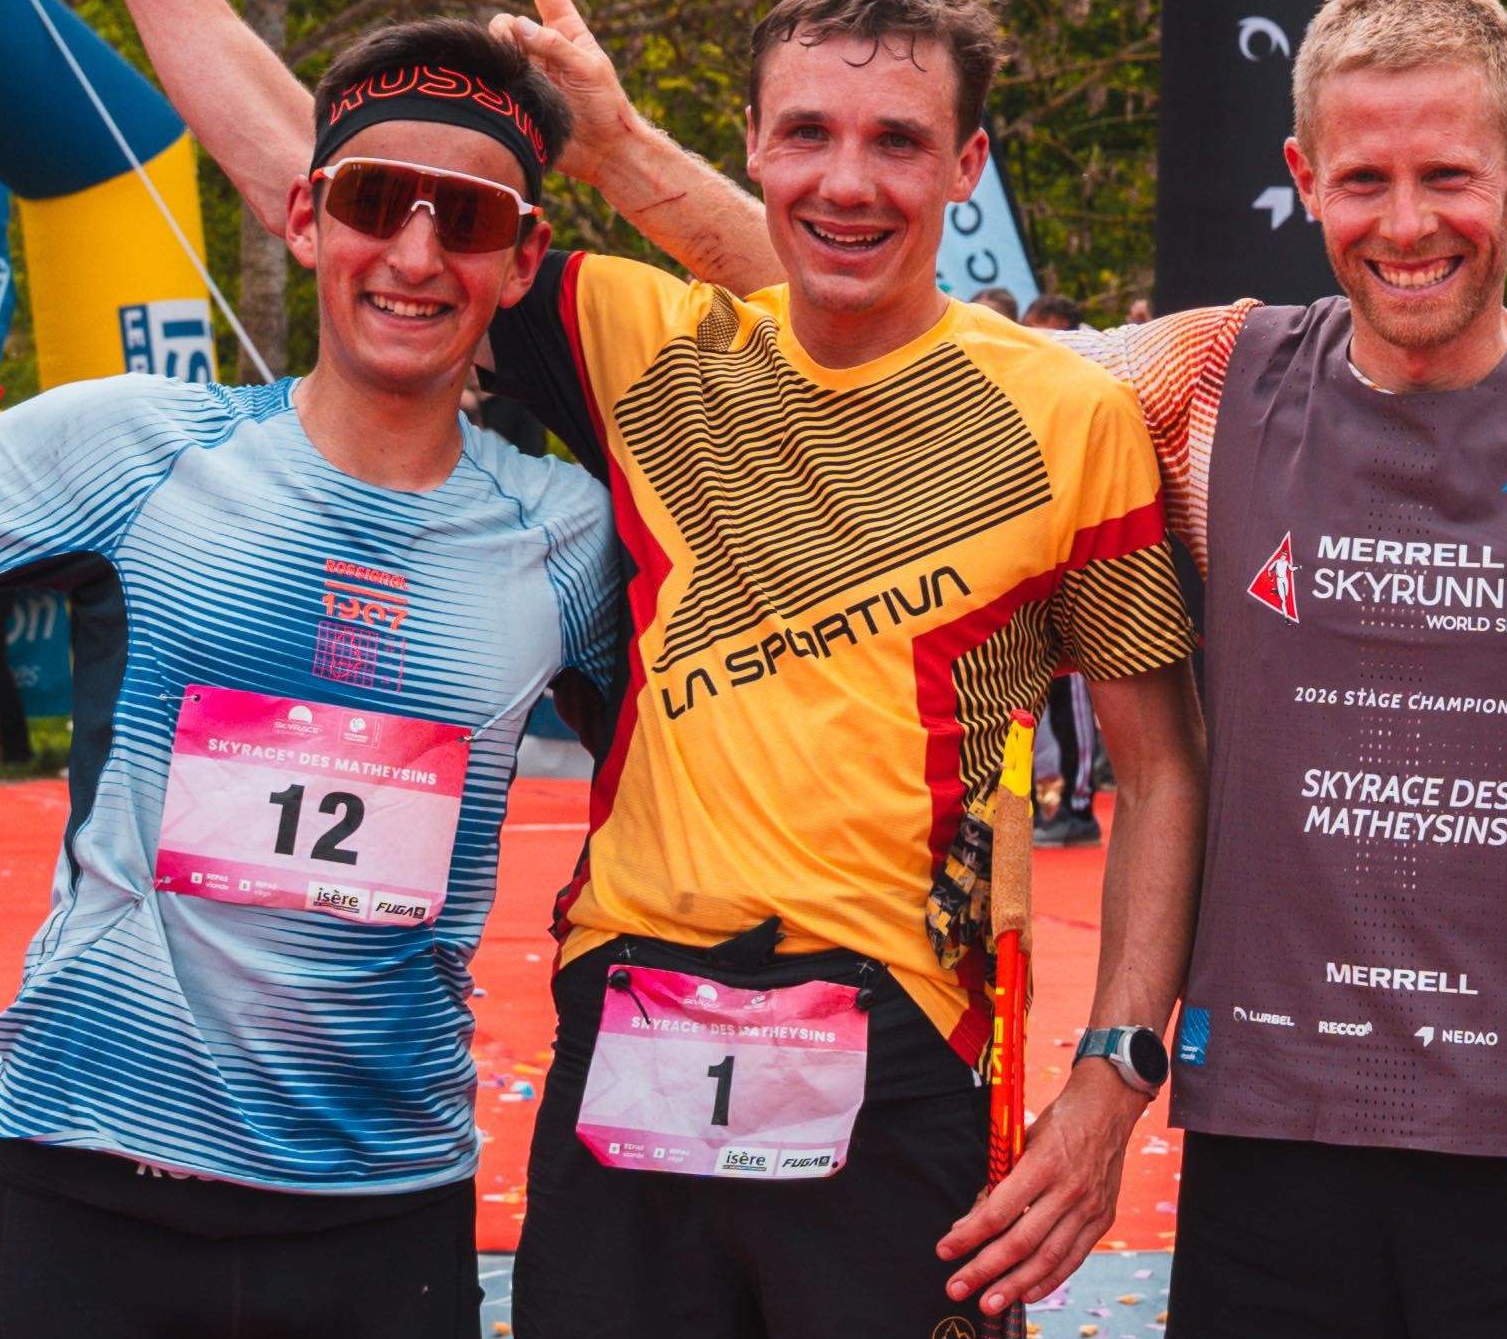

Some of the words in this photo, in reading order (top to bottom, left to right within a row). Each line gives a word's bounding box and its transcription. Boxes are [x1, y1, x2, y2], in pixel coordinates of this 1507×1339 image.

[1317, 536, 1505, 568] MERRELL
[322, 592, 408, 631] 1907
[1425, 614, 1490, 632] WORLD
[661, 668, 718, 721] LA
[730, 565, 972, 689] SPORTIVA
[1294, 687, 1338, 706] 2026
[1344, 690, 1401, 709] STAGE
[300, 753, 330, 768] DES
[335, 758, 438, 785] MATHEYSINS
[1301, 769, 1445, 807] SKYRACE
[268, 783, 366, 866] 12
[316, 887, 360, 908] isère
[1326, 962, 1479, 996] MERRELL
[710, 1023, 735, 1036] DES
[1249, 1010, 1295, 1027] LURBEL
[1318, 1021, 1367, 1037] RECCO
[1442, 1029, 1498, 1046] NEDAO
[706, 1055, 735, 1125] 1
[726, 1151, 766, 1166] isère
